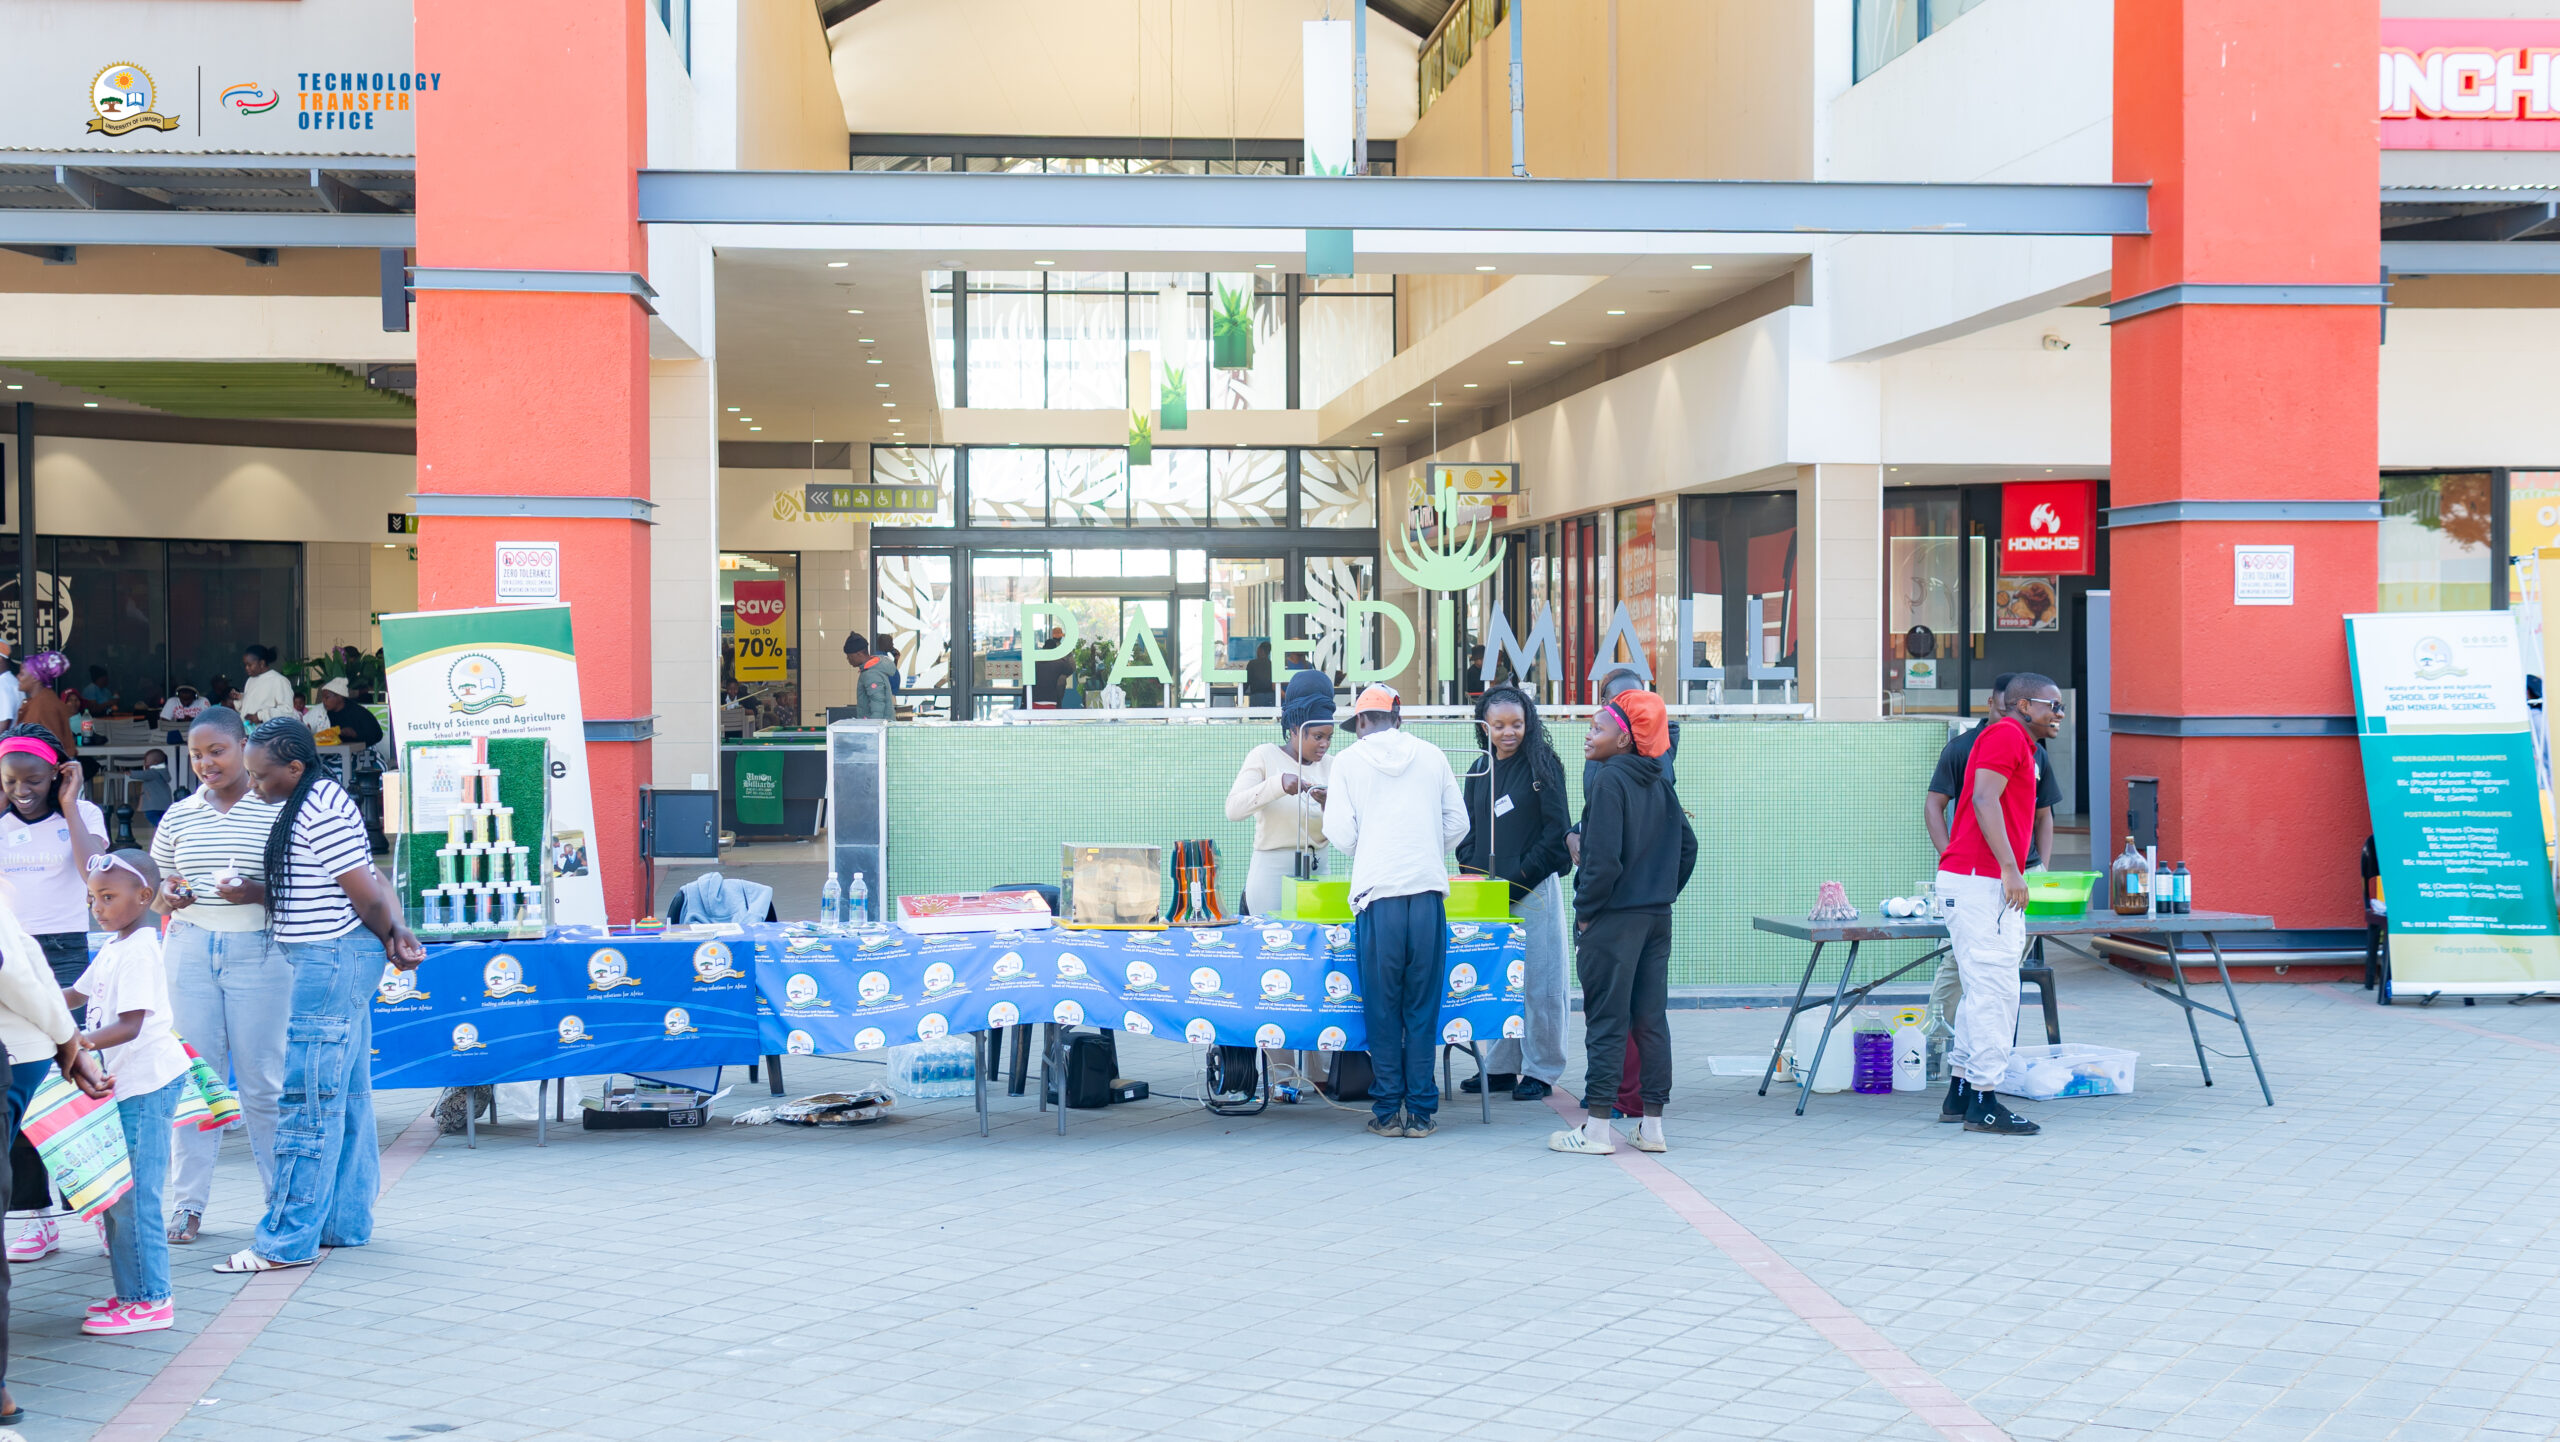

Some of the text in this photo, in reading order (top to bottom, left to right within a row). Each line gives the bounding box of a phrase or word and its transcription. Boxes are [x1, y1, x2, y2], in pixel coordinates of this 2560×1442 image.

[2380, 53, 2560, 112] NCH
[2008, 536, 2080, 550] HONCHOS
[504, 568, 551, 578] ZERO TOLERANCE
[736, 599, 784, 615] save
[1, 609, 54, 626] FIH
[750, 628, 762, 636] up
[739, 638, 783, 658] 70%
[408, 712, 566, 731] Faculty of Science and Agriculture
[434, 731, 454, 739] School
[502, 725, 526, 734] Mineral
[527, 724, 552, 732] Sciences
